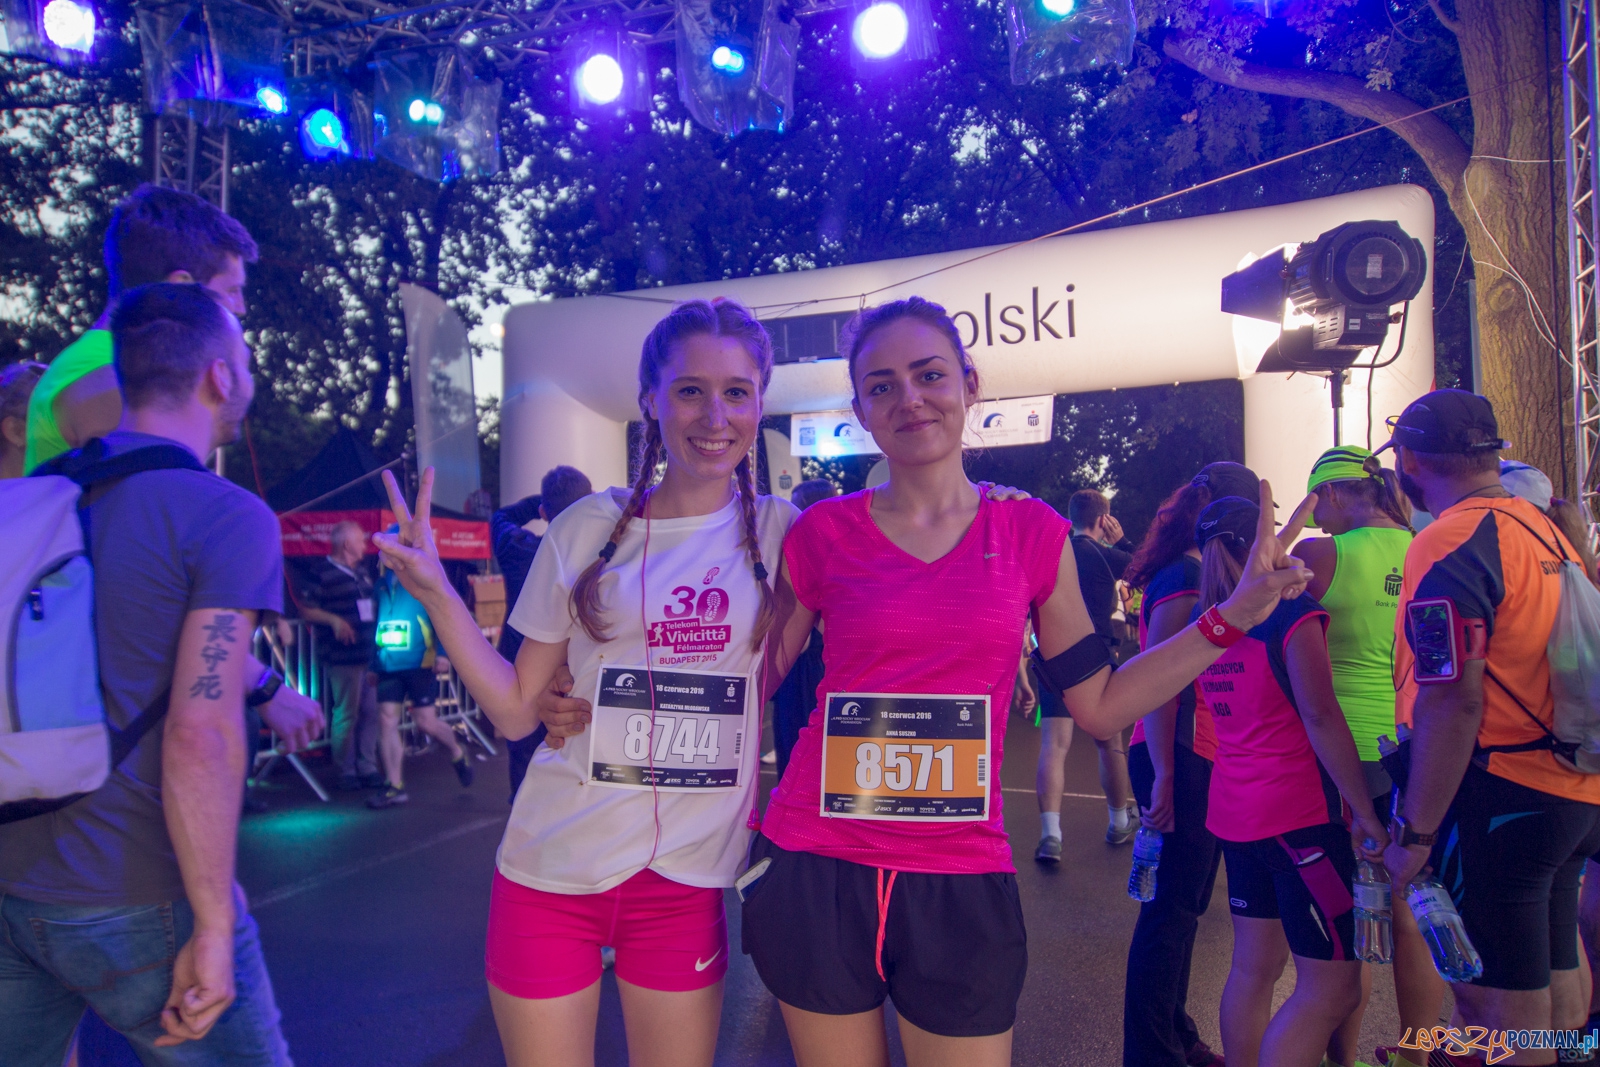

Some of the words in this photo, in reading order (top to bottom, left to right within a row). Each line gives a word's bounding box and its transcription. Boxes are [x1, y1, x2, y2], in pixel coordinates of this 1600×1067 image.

[953, 282, 1077, 348] olski
[664, 586, 729, 624] 30
[665, 621, 698, 630] Telekom
[666, 628, 727, 643] Vivicittá
[659, 656, 700, 665] BUDAPEST
[701, 654, 718, 662] 2015
[656, 684, 664, 692] 18
[664, 685, 690, 694] czerwca
[880, 711, 888, 719] 18
[888, 711, 916, 719] czerwca
[916, 712, 932, 720] 2016
[1213, 702, 1232, 717] AGA
[624, 713, 720, 764] 8744
[898, 730, 917, 738] SUSZKO
[855, 742, 954, 792] 8571
